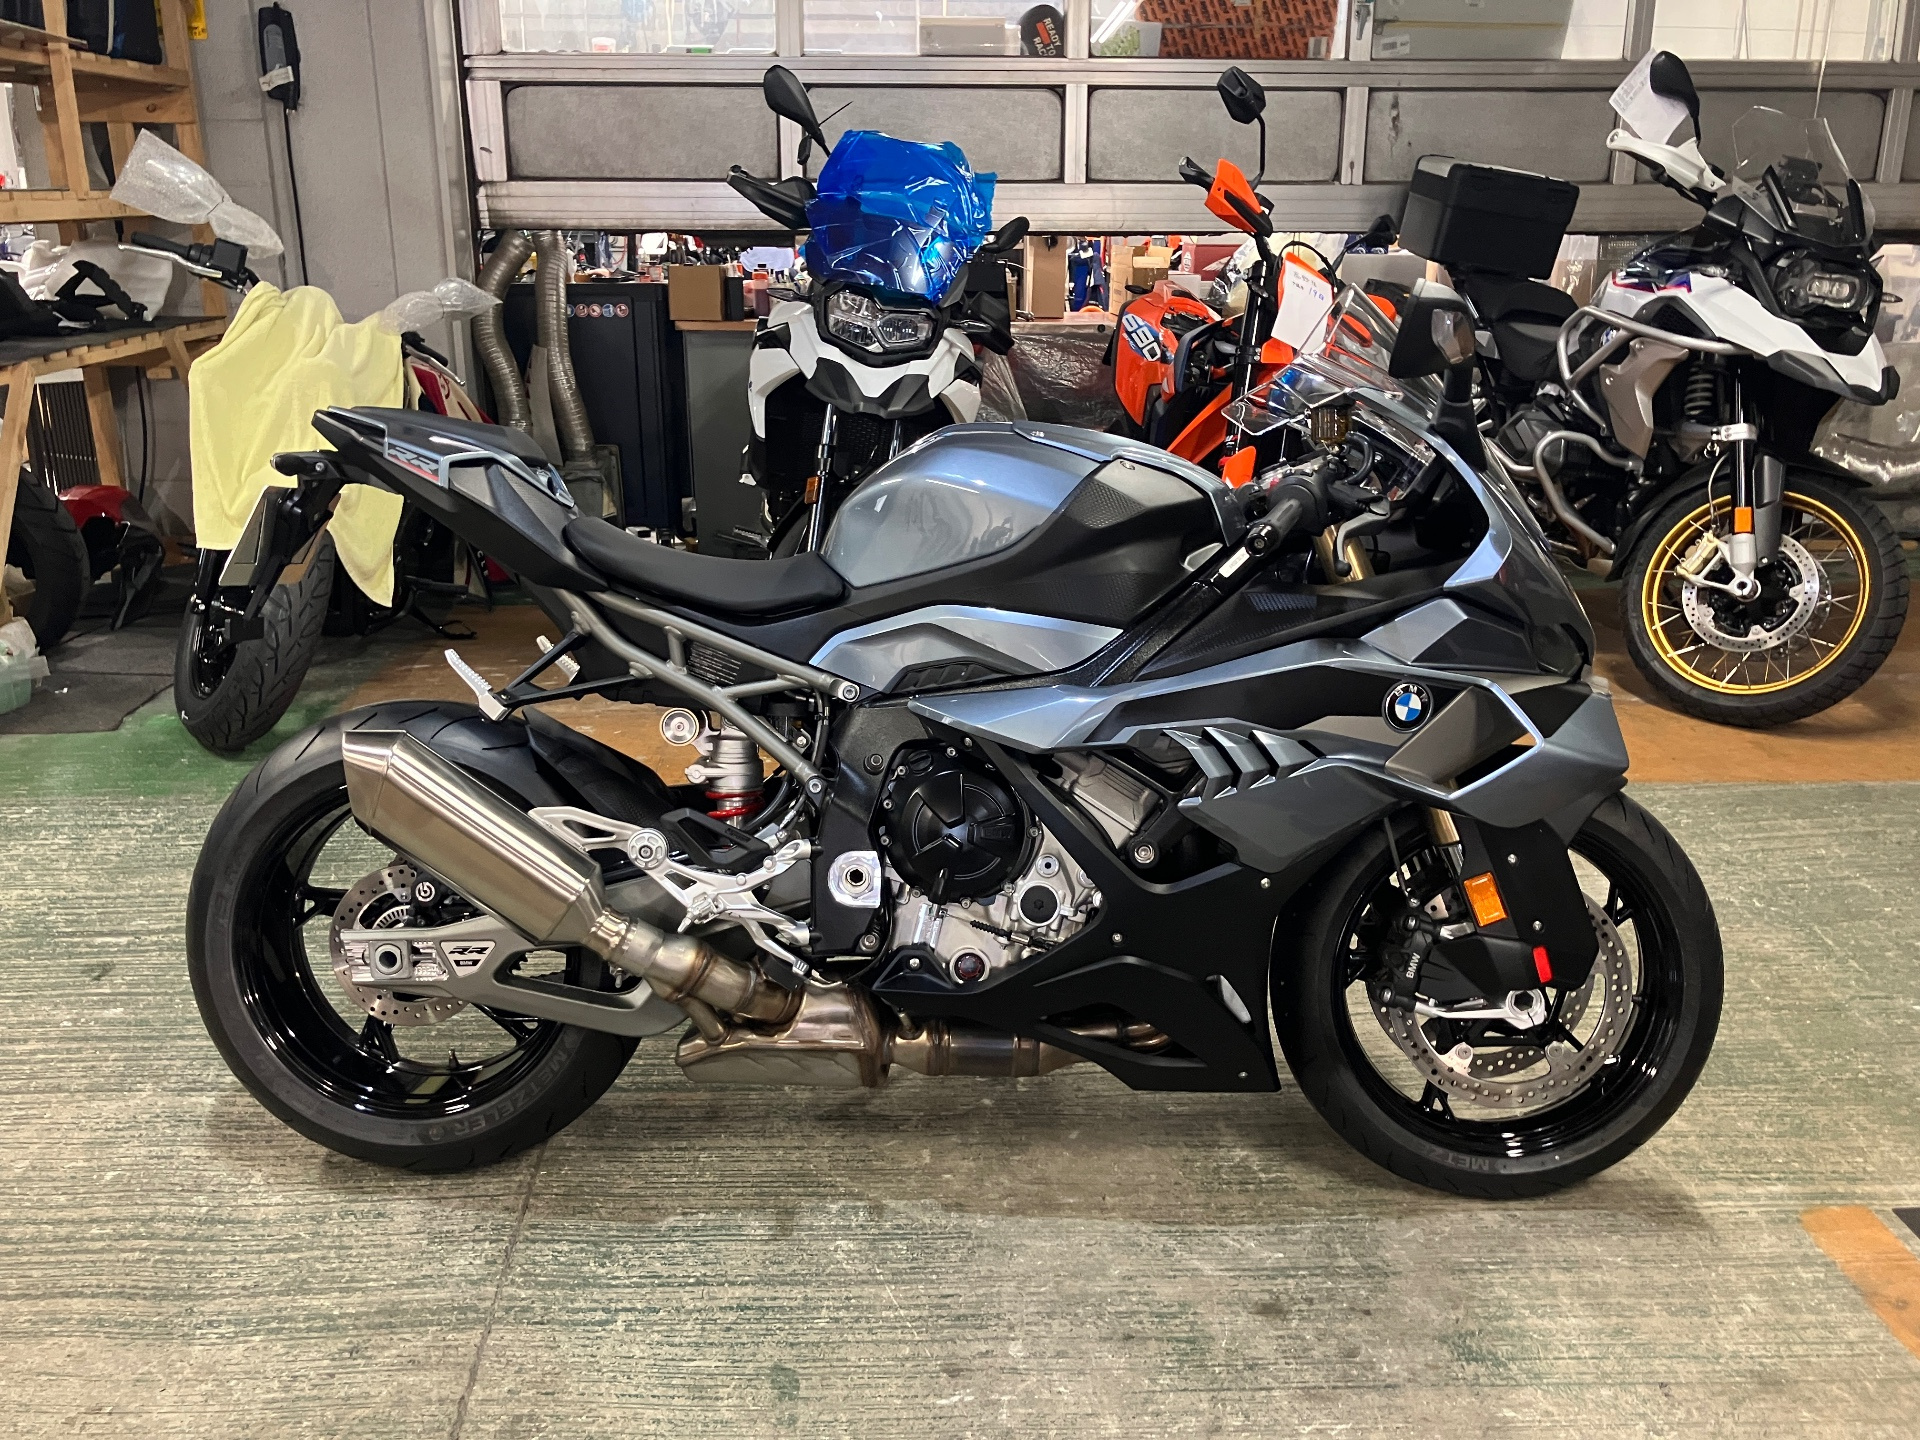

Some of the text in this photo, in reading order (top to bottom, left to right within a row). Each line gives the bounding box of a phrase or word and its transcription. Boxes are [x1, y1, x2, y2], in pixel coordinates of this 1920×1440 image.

[1043, 18, 1061, 46] READY
[1046, 43, 1056, 56] TO
[1122, 313, 1161, 362] 690
[387, 446, 440, 475] RR
[1394, 684, 1428, 702] BMW
[448, 945, 490, 956] RR
[1405, 952, 1420, 979] BMW
[455, 1050, 569, 1137] METZELER
